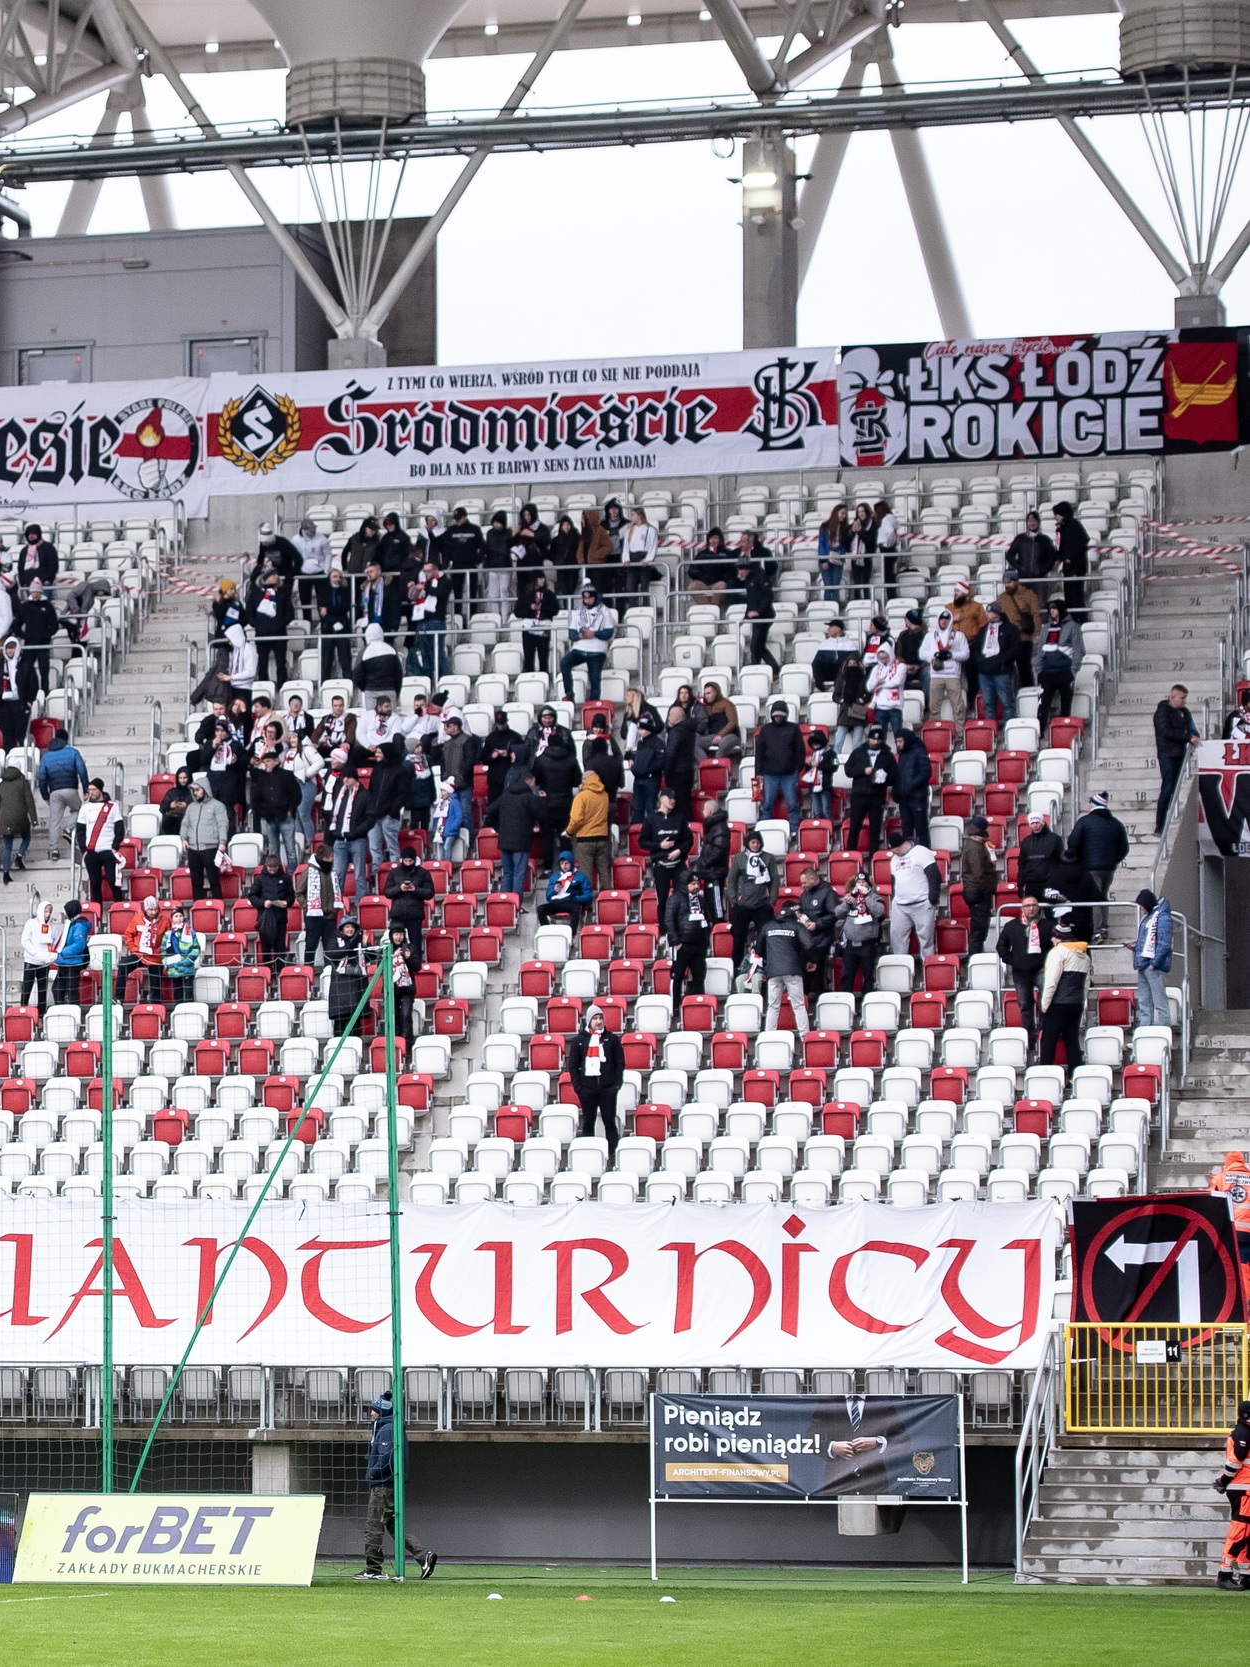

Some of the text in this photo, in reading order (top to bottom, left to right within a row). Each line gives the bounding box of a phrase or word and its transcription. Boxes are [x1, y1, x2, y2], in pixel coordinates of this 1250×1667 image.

[387, 376, 394, 391] Z
[398, 375, 425, 390] TYMI
[430, 375, 444, 389] CO
[502, 368, 544, 386] WŚRÓD
[549, 369, 579, 384] TYCH
[583, 368, 598, 382] CO
[602, 367, 619, 383] SIĘ
[623, 365, 642, 380] NIE
[906, 339, 1167, 401] ŁKS ŁÓDŹ
[315, 379, 716, 474] Śródmieście
[907, 397, 1164, 459] ROKICIE
[409, 463, 426, 477] BO
[430, 462, 452, 477] DLA
[456, 461, 477, 476] NAS
[481, 461, 495, 475] TE
[498, 459, 540, 474] BARWY
[544, 457, 569, 472] SENS
[573, 455, 605, 471] ŻYCIA
[5, 915, 16, 926] 15
[1184, 1119, 1207, 1127] 01-15
[1173, 1154, 1196, 1162] 01-15
[663, 1404, 762, 1432] Pieniądz
[664, 1432, 822, 1459] robi pieniądz!
[672, 1467, 782, 1479] ARCHITEKT-FINANSOWY.PL
[61, 1505, 275, 1555] forBET
[57, 1562, 263, 1576] ZAKŁADY BUKMACHERSKIE
